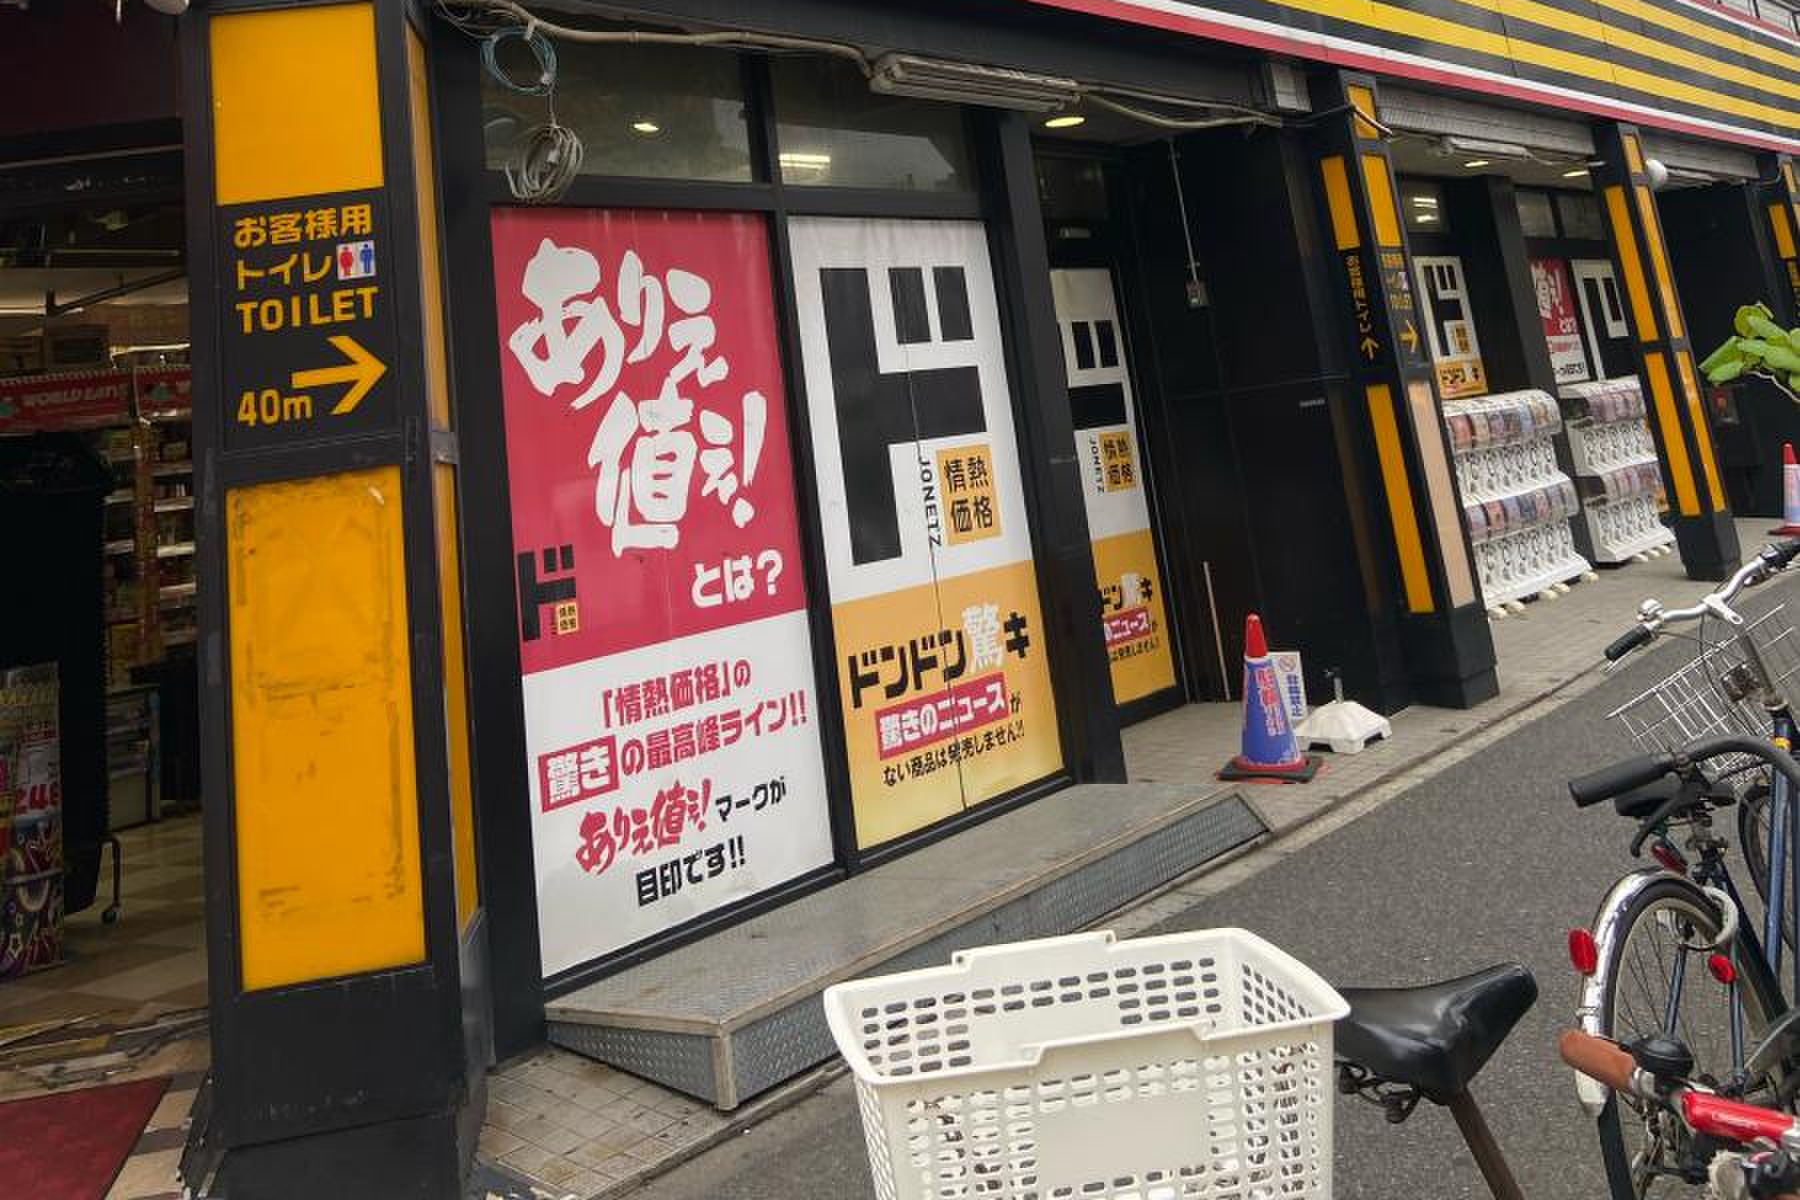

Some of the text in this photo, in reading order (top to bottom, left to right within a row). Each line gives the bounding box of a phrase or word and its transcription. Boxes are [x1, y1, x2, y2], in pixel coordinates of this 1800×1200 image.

[233, 203, 373, 248] お客様用
[236, 253, 333, 290] トイレ
[235, 286, 379, 334] TOILET
[237, 388, 313, 427] 40m
[818, 266, 987, 567] ド
[944, 456, 990, 494] 情熱
[918, 457, 943, 548] JONETZ
[950, 496, 994, 533] 価格
[517, 545, 577, 642] ド
[691, 549, 784, 609] とは?
[848, 603, 1031, 709] ドンドン驚キ
[636, 835, 746, 907] 目印です!!
